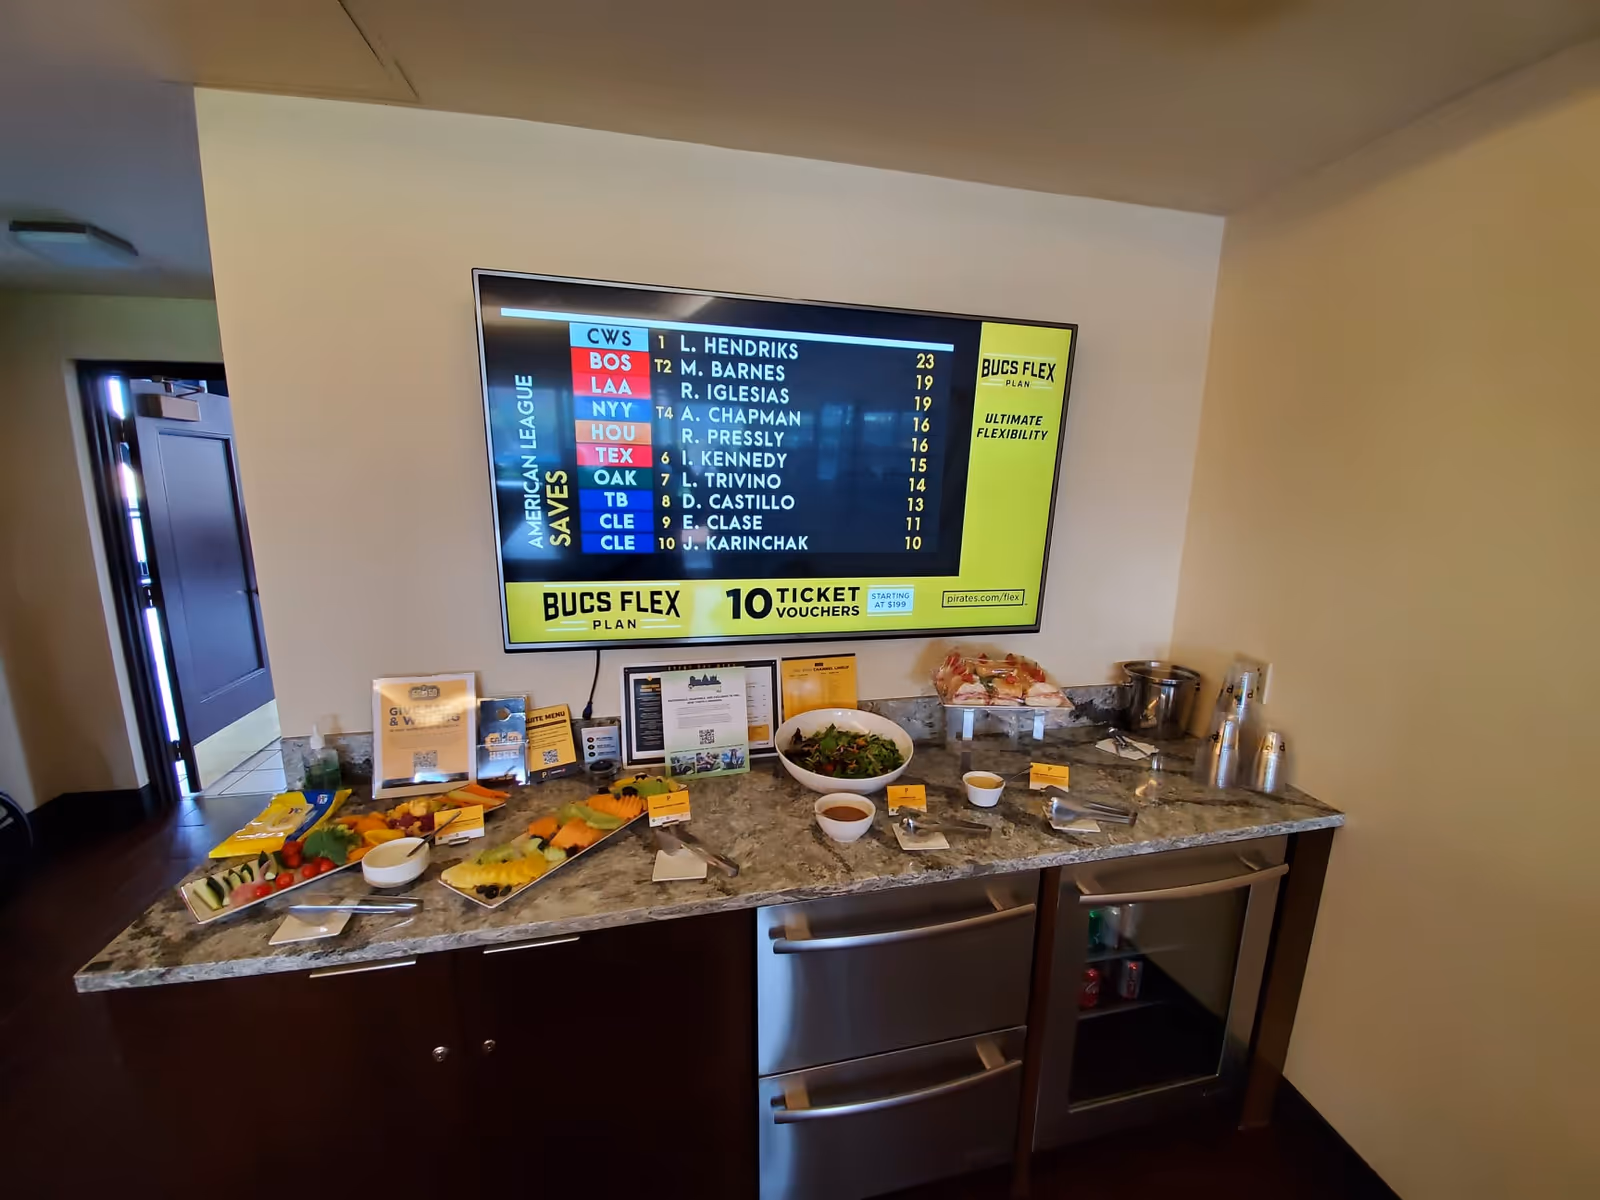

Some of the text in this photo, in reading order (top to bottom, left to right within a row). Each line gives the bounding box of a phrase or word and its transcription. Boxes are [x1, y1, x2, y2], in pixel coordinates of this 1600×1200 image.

[587, 328, 935, 369] CWS 1 L. HENDRIKS 23
[589, 352, 934, 390] BOS T2 M. BARNES 19
[981, 358, 1057, 383] BUCS FLEX
[591, 376, 932, 411] LAA R. IGLESIAS 19
[1005, 379, 1031, 388] PLAN
[592, 401, 930, 433] NYY T4 A. CHAPMAN 16
[985, 413, 1043, 426] ULTIMATE
[591, 423, 929, 453] HOU R. PRESSLY 16
[976, 427, 1048, 441] FLEXIBILITY
[515, 374, 544, 549] AMERICAN LEAGUE
[595, 447, 927, 472] TEX 6 I. KENNEDY 15
[593, 469, 926, 492] OAK 7 L. TRIVINO 14
[545, 470, 571, 547] SAVES
[604, 491, 924, 512] TB 8 D. CASTILLO 13
[600, 513, 921, 531] CLE 9 E. CLASE 11
[601, 534, 922, 551] CLE 10 J. KARINCHAK 10
[725, 587, 773, 620] 10
[776, 586, 860, 603] TICKET
[871, 592, 910, 600] STARTING
[874, 600, 907, 609] AT $199
[946, 592, 1020, 604] pirates.com/flex
[543, 590, 681, 621] BUCS FLEX
[776, 605, 860, 618] VOUCHERS
[593, 618, 637, 630] PLAN
[526, 711, 566, 724] UITE MENU
